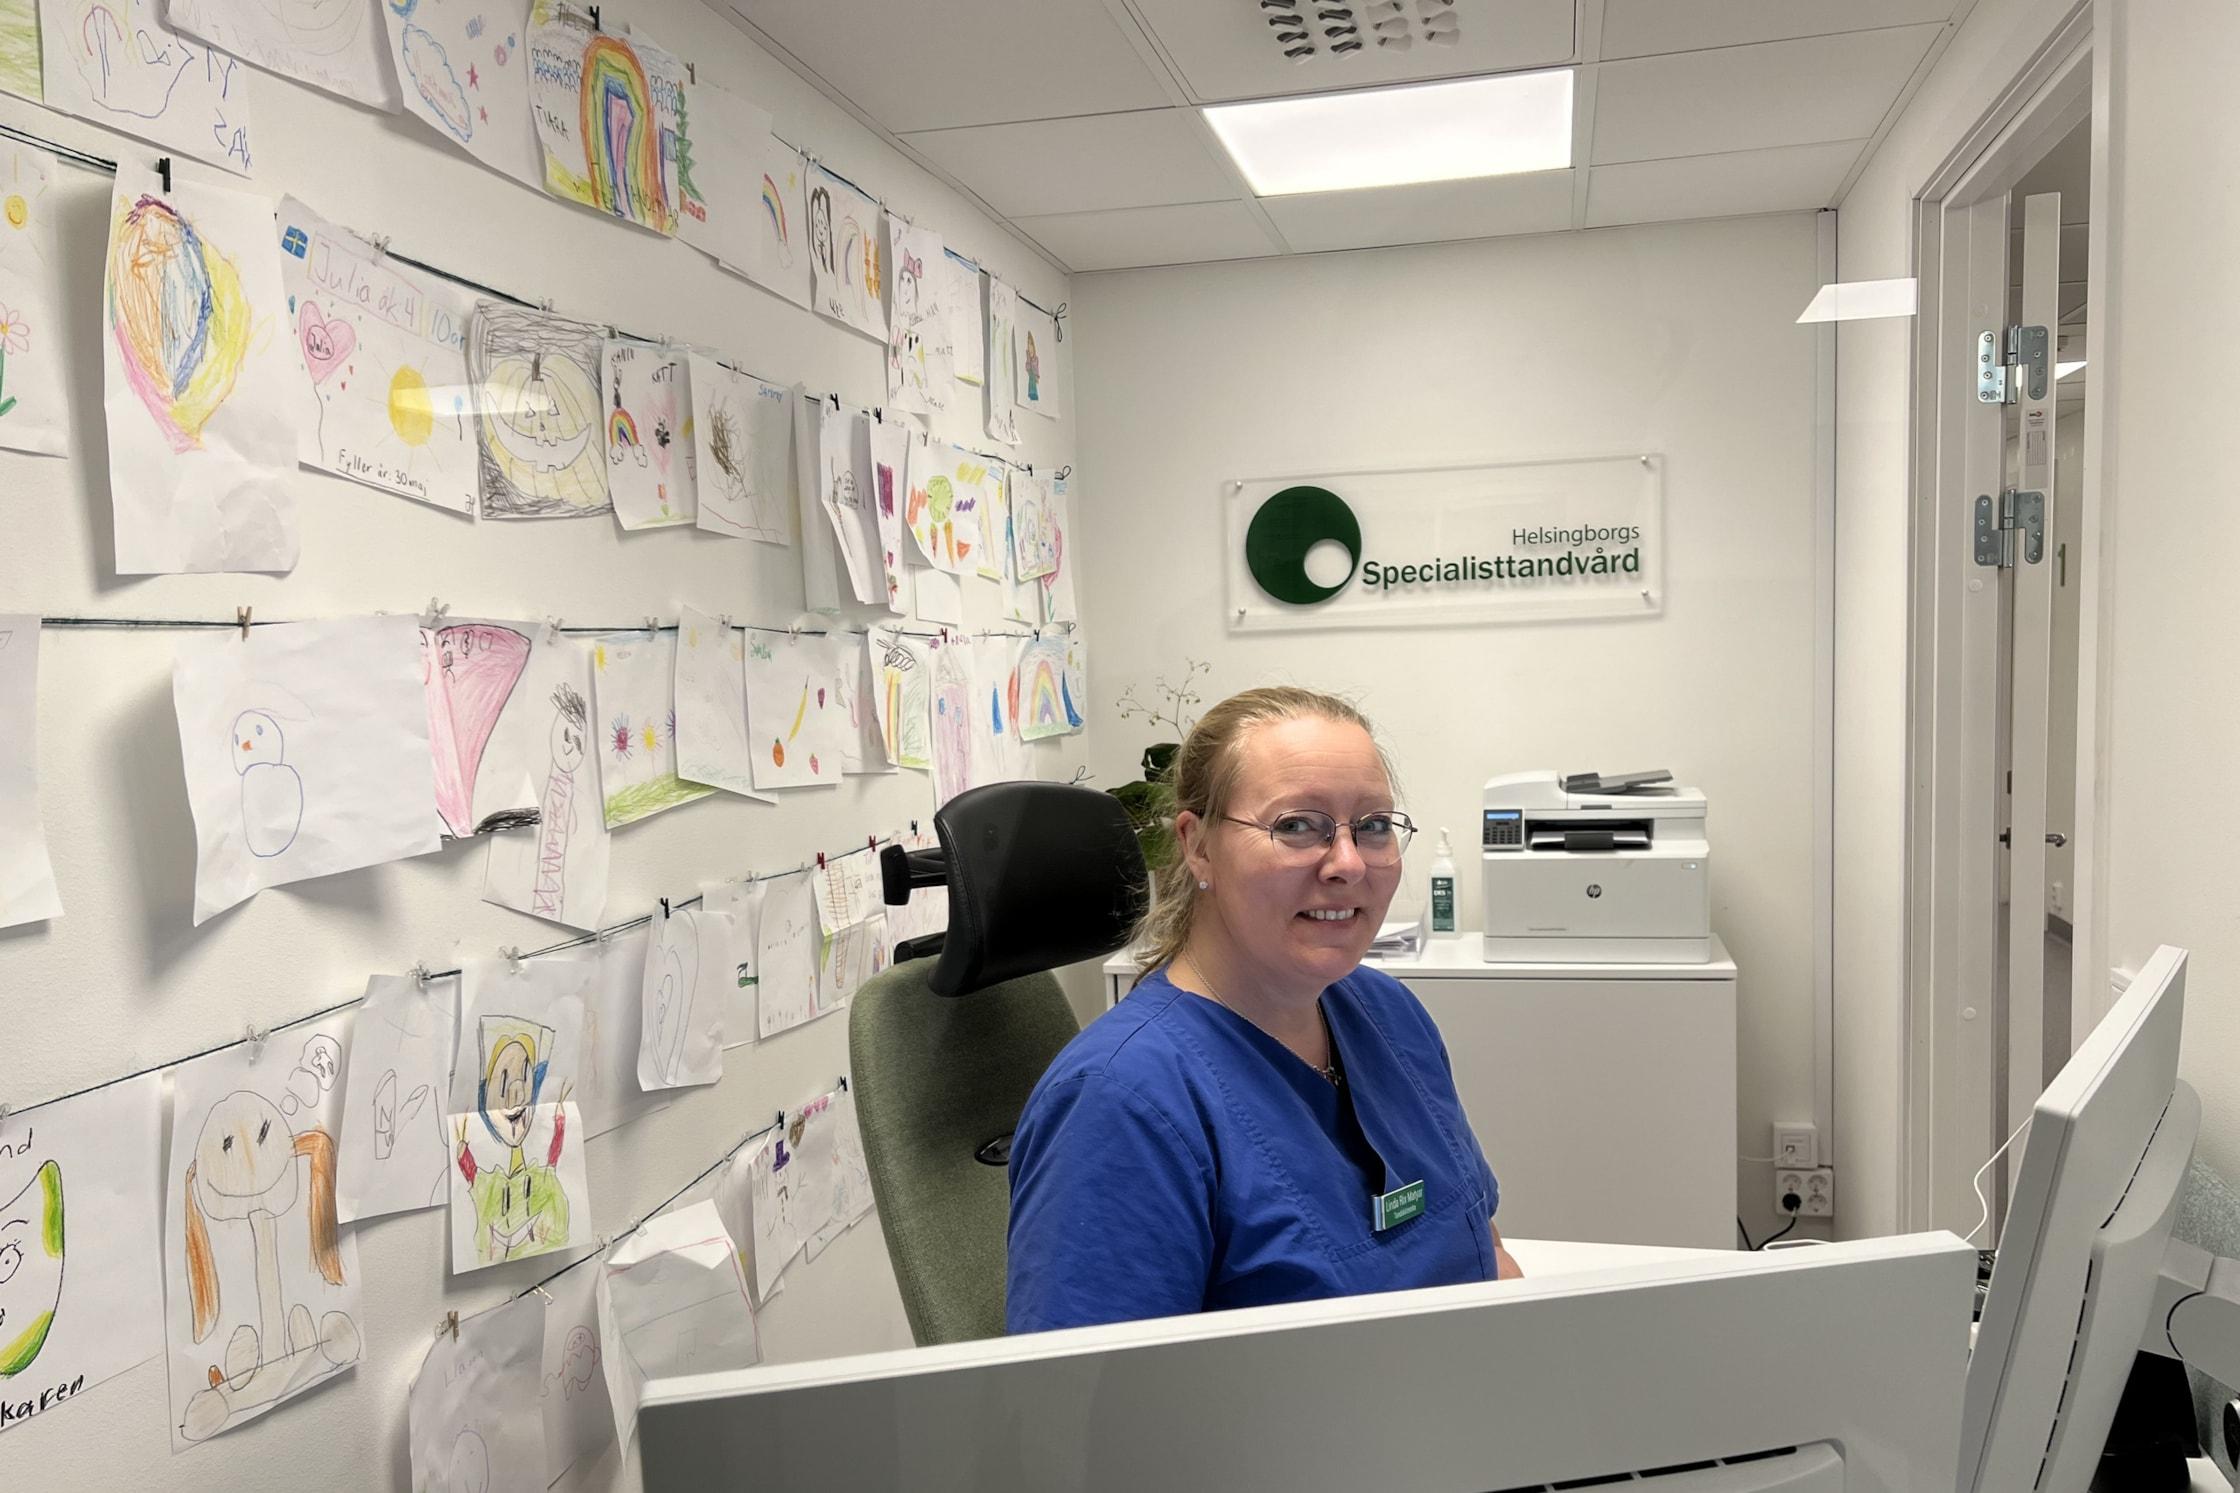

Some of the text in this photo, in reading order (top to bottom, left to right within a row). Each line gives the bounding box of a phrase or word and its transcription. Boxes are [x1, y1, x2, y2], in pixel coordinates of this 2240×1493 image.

[338, 448, 372, 473] Fyller
[1513, 524, 1640, 547] Helsingborgs
[1362, 547, 1639, 590] Specialisttandvård
